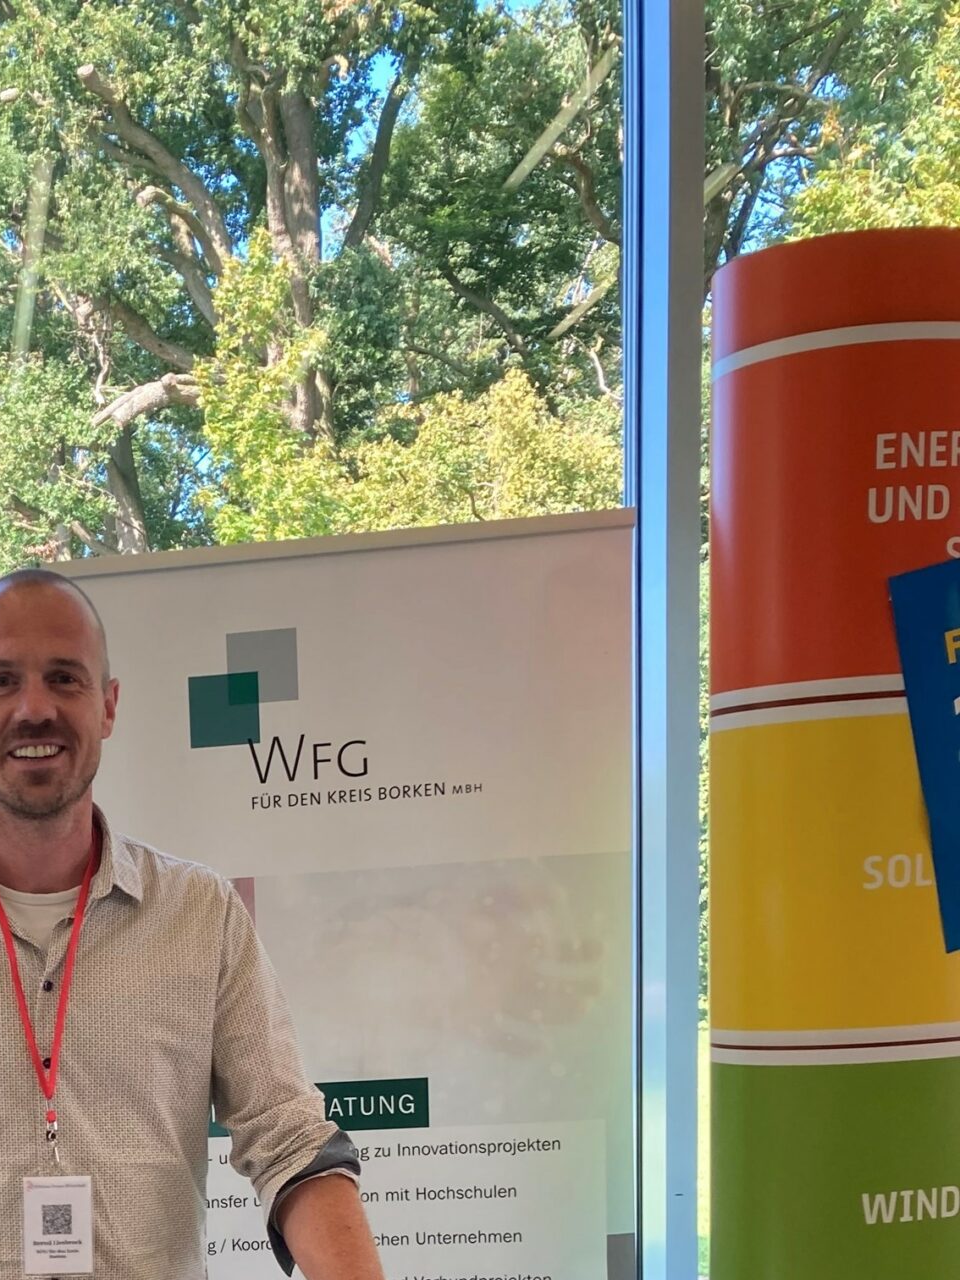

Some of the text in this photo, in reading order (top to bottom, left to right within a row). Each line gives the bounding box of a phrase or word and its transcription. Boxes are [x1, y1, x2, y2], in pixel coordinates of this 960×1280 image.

[868, 484, 950, 524] UND
[247, 734, 369, 784] WFG
[251, 782, 483, 810] FÜR DEN KREIS BORKEN MBH
[373, 1145, 391, 1158] zu
[397, 1137, 561, 1157] Innovationsprojekten
[385, 1187, 410, 1202] mit
[415, 1185, 517, 1201] Hochschulen
[861, 1185, 960, 1225] WIND
[415, 1230, 523, 1246] Unternehmen
